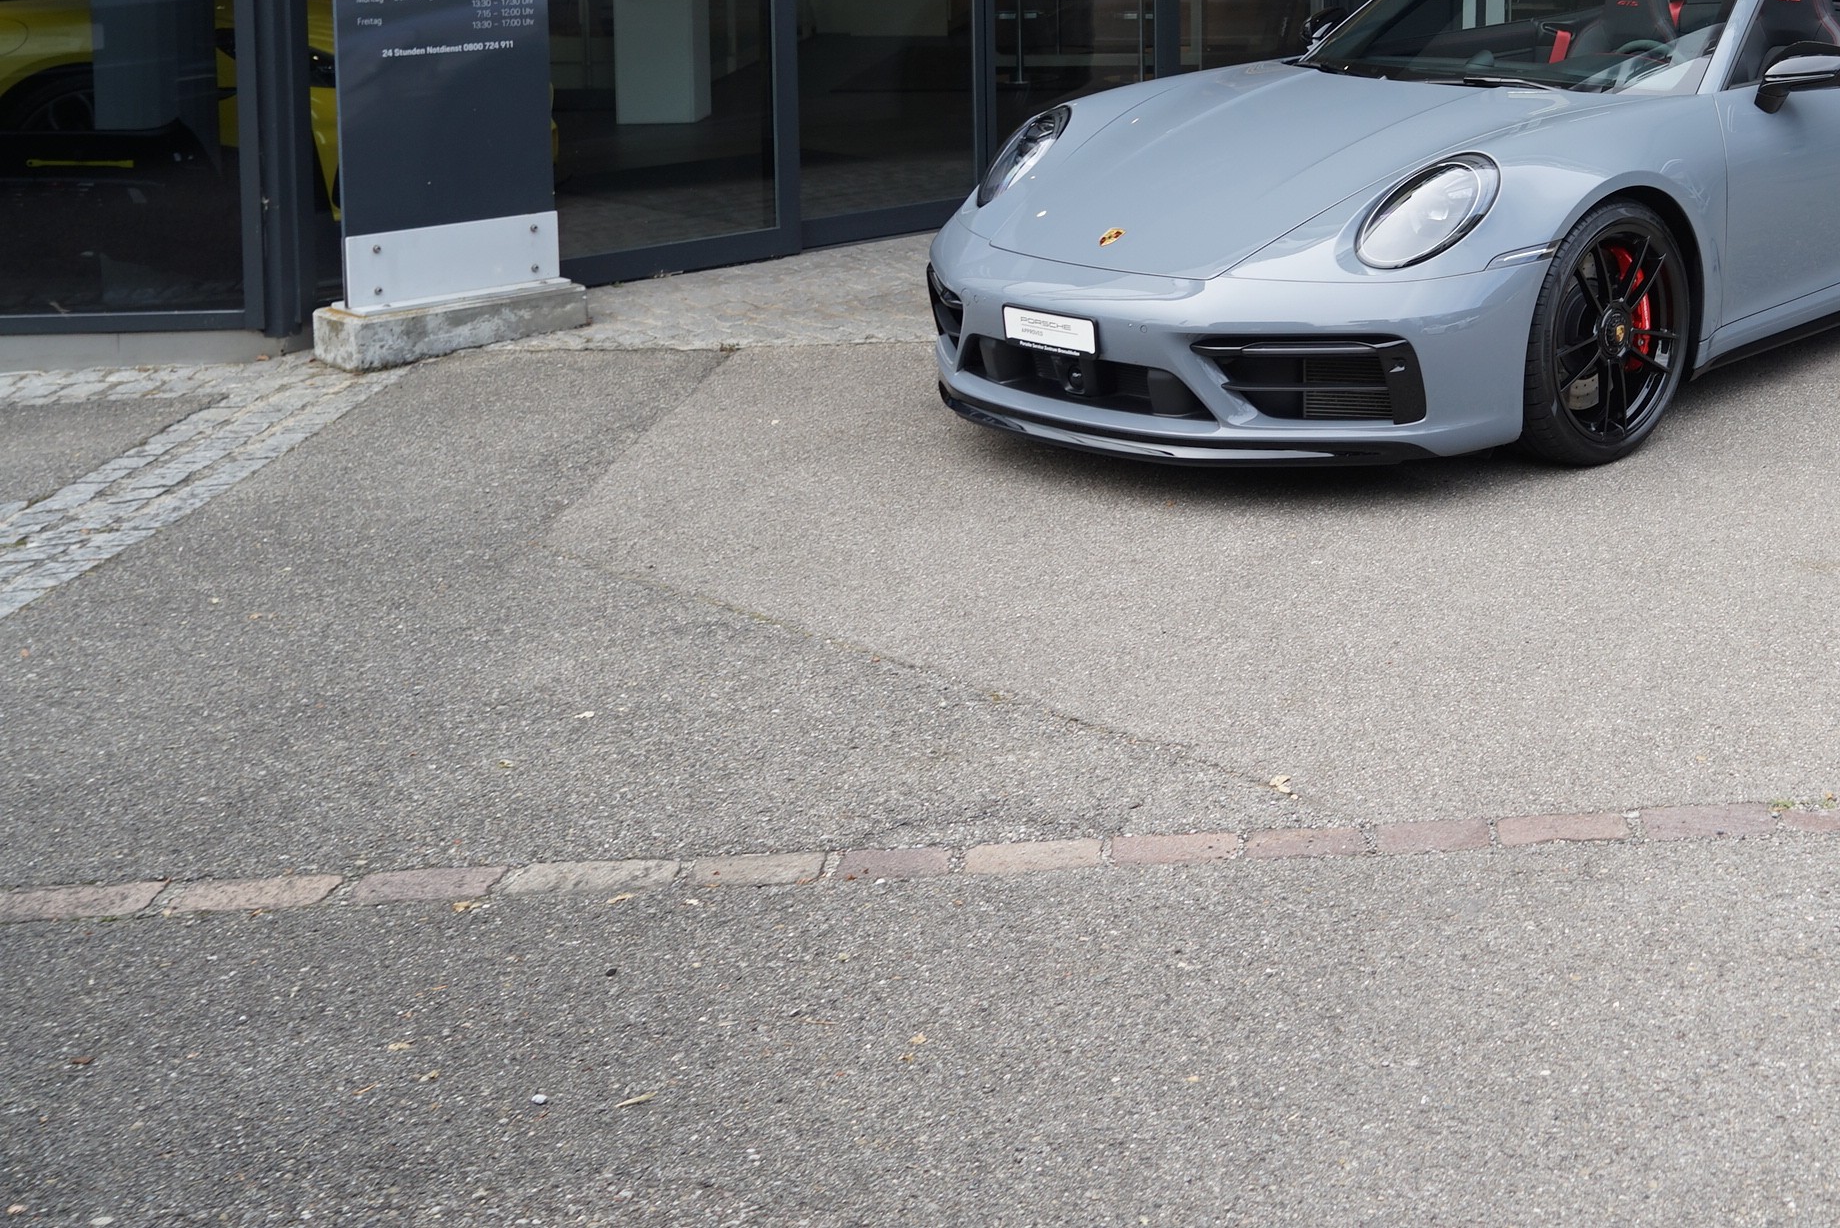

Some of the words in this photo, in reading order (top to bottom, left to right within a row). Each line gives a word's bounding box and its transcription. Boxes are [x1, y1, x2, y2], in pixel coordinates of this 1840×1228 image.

[1616, 0, 1639, 7] GTS
[522, 8, 534, 16] Uhr
[357, 17, 382, 26] Freitag
[522, 18, 535, 26] Uhr
[382, 49, 393, 58] 24
[394, 47, 426, 57] Stunden
[426, 44, 462, 54] Notdienst
[463, 42, 483, 52] 0800
[484, 40, 499, 50] 724
[500, 40, 514, 49] 911
[1021, 317, 1071, 331] PORSCHE
